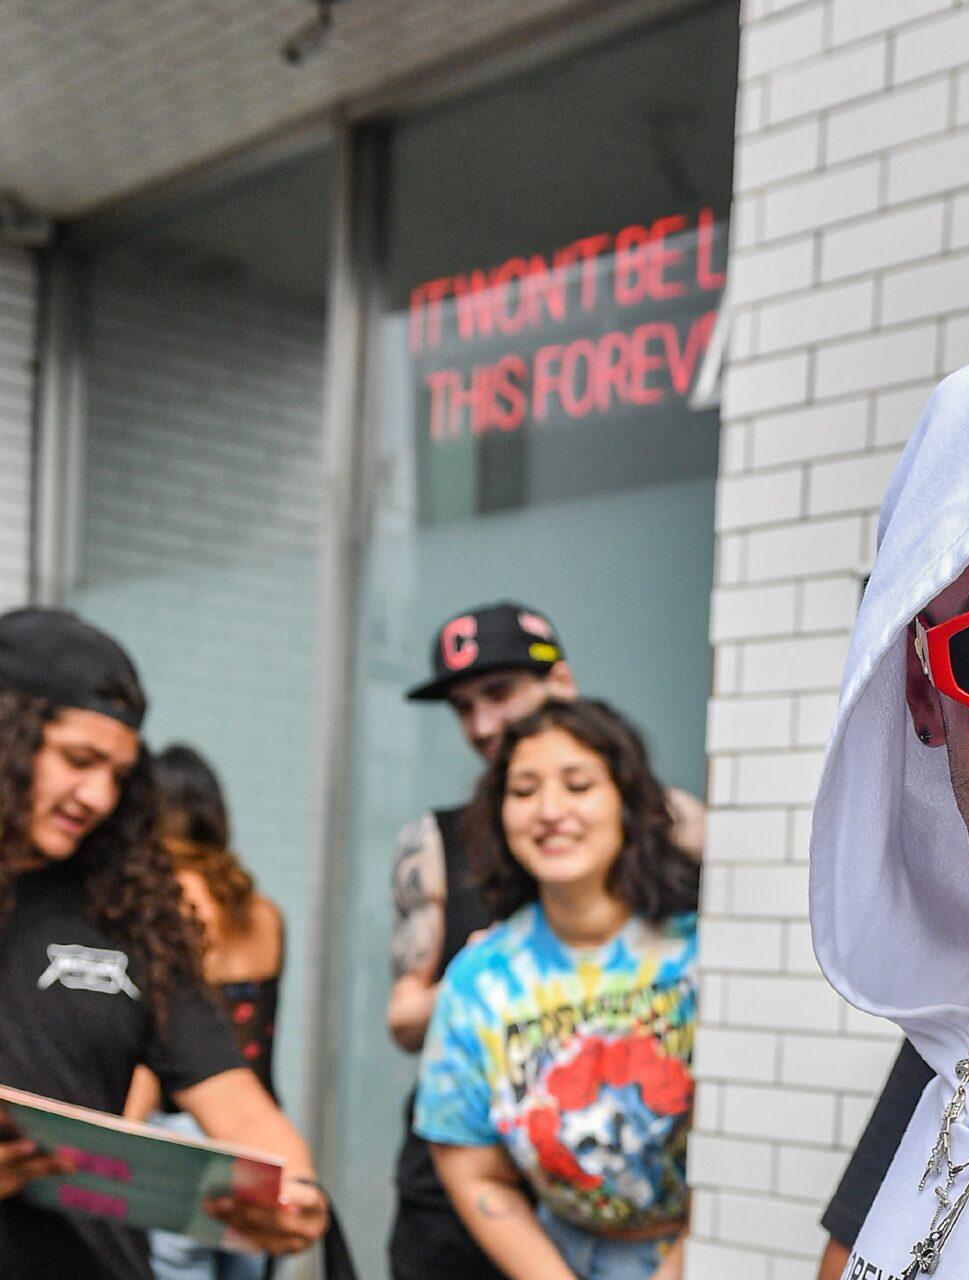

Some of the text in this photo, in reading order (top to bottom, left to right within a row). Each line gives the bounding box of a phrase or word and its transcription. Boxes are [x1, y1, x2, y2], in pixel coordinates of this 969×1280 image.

[409, 277, 453, 355] IT
[614, 213, 687, 306] BE
[426, 354, 528, 443] THIS
